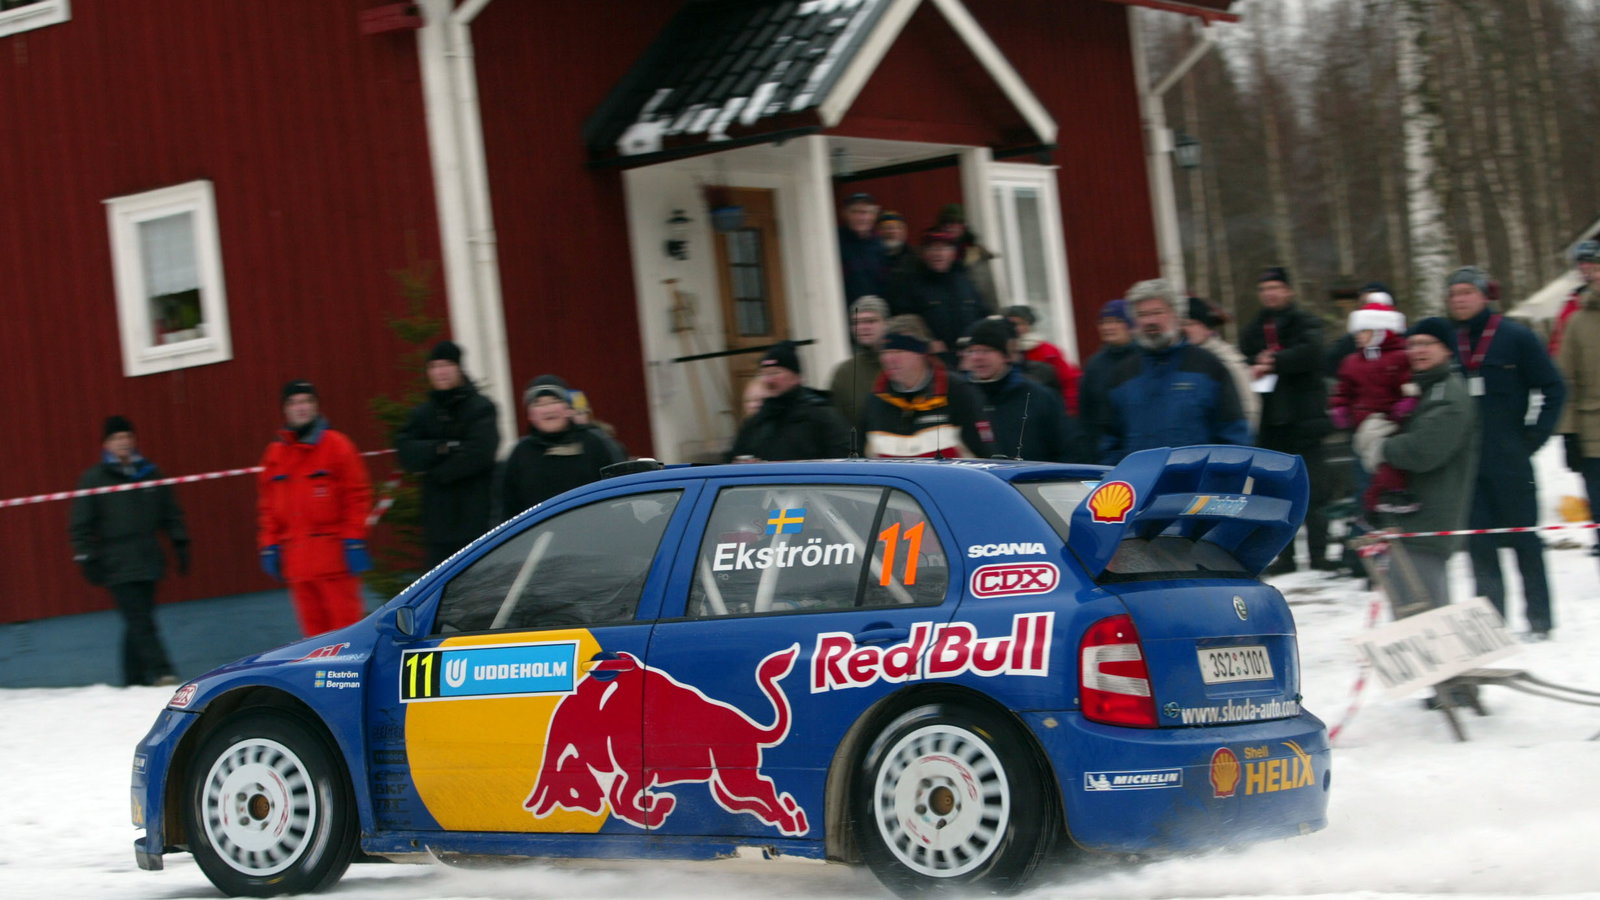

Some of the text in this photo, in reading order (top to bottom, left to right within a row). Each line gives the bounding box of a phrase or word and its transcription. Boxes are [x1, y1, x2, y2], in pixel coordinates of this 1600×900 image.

[713, 538, 855, 571] Ekström
[879, 521, 925, 586] 11
[968, 542, 1047, 558] SCANIA
[980, 568, 1048, 592] CDX
[811, 612, 1055, 693] Red Bull
[327, 670, 359, 679] Ekström
[406, 652, 434, 698] 11
[474, 661, 567, 681] UDDEHOLM
[326, 680, 360, 689] Bergman
[1244, 746, 1269, 759] Shell
[1113, 773, 1178, 785] MICHELIN
[1245, 748, 1315, 795] HELIX
